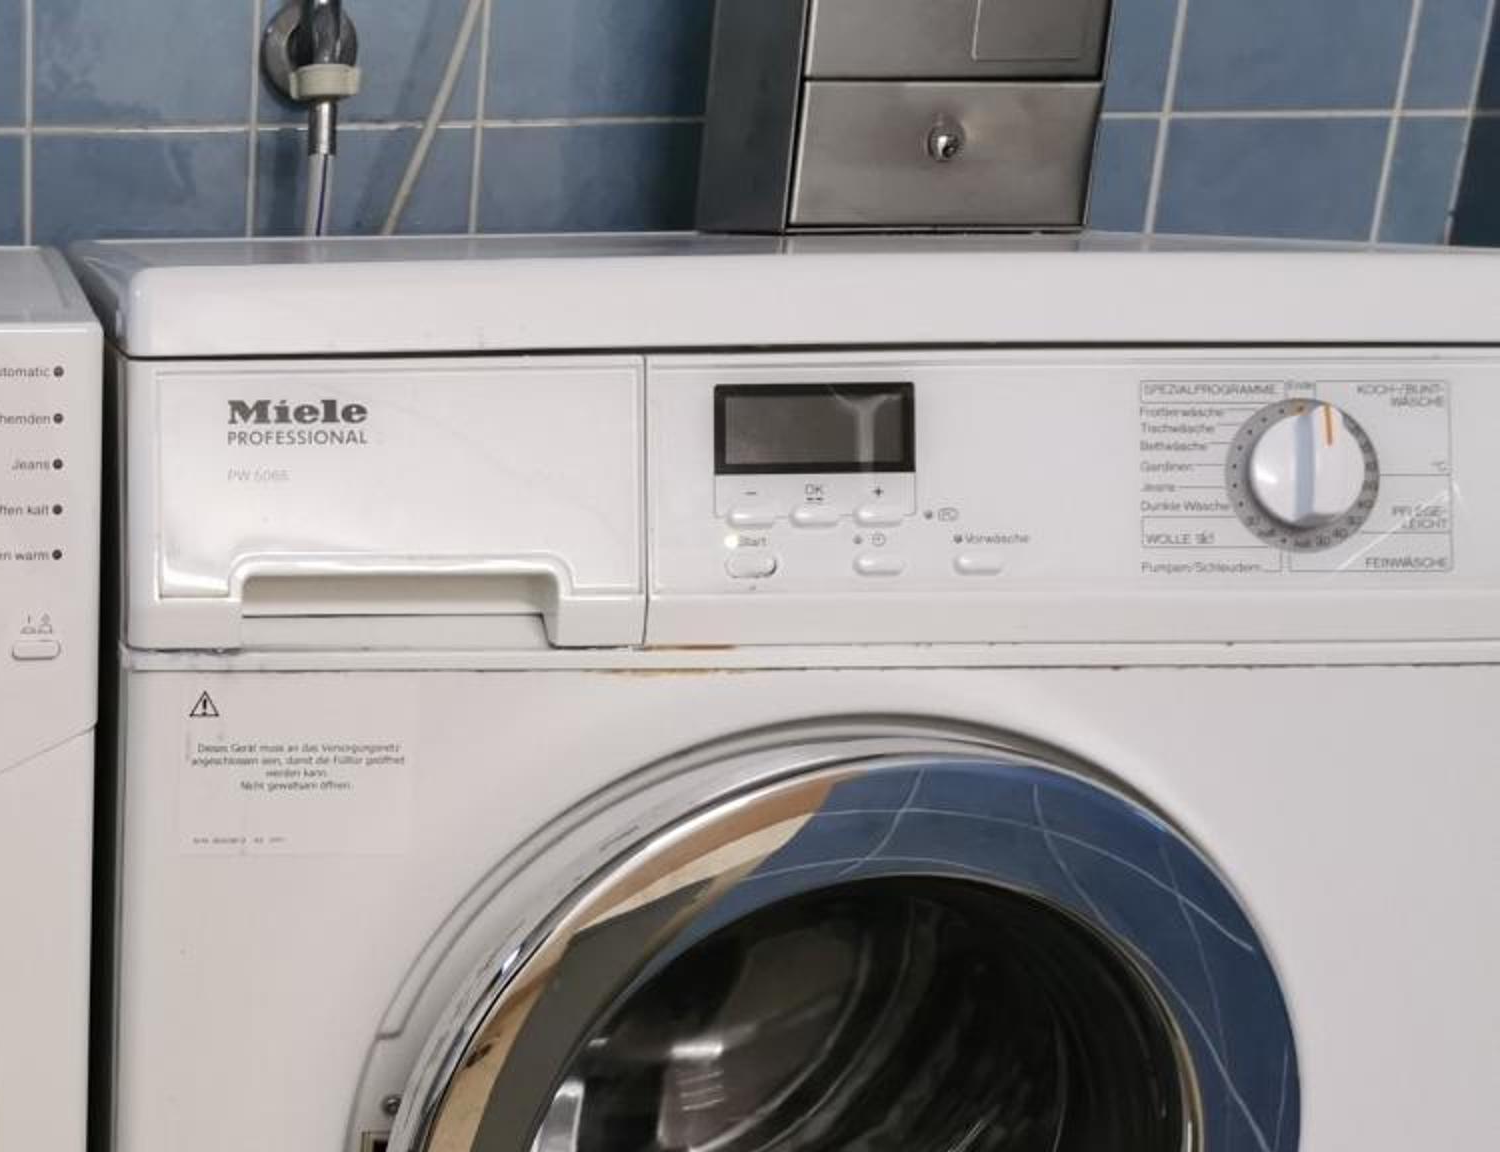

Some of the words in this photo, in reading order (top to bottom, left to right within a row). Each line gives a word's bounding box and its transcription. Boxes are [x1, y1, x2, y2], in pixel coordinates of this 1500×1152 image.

[228, 399, 368, 424] Miele
[227, 429, 368, 446] PROFESSIONAL
[11, 459, 50, 471] Jeans
[805, 483, 824, 495] OK
[27, 504, 50, 517] kalt
[15, 552, 49, 562] warm
